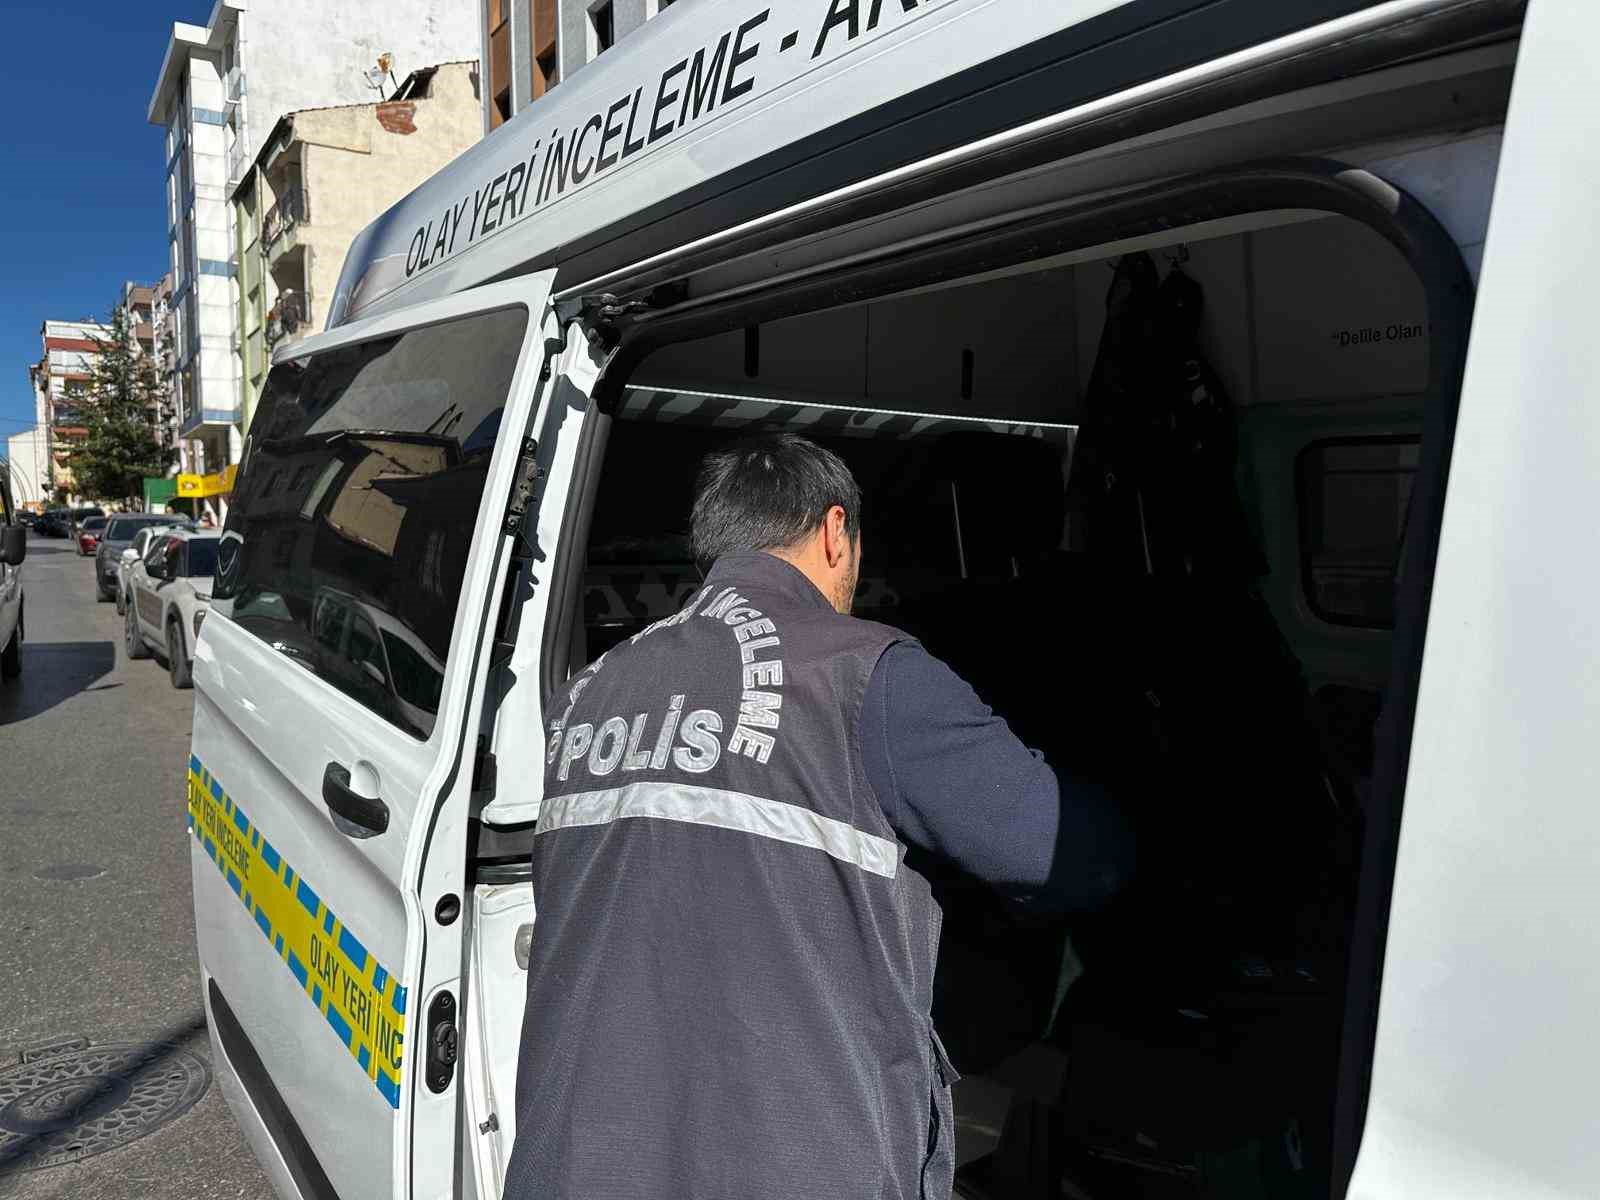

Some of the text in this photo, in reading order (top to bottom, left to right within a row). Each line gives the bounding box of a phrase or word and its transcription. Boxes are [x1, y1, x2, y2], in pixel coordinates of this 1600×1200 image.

[405, 196, 469, 277] OLAY
[469, 139, 541, 242] YERİ
[535, 8, 770, 207] İNCELEME
[557, 694, 723, 781] POLİS
[310, 933, 339, 993] OLAY
[342, 969, 373, 1036] YERİ
